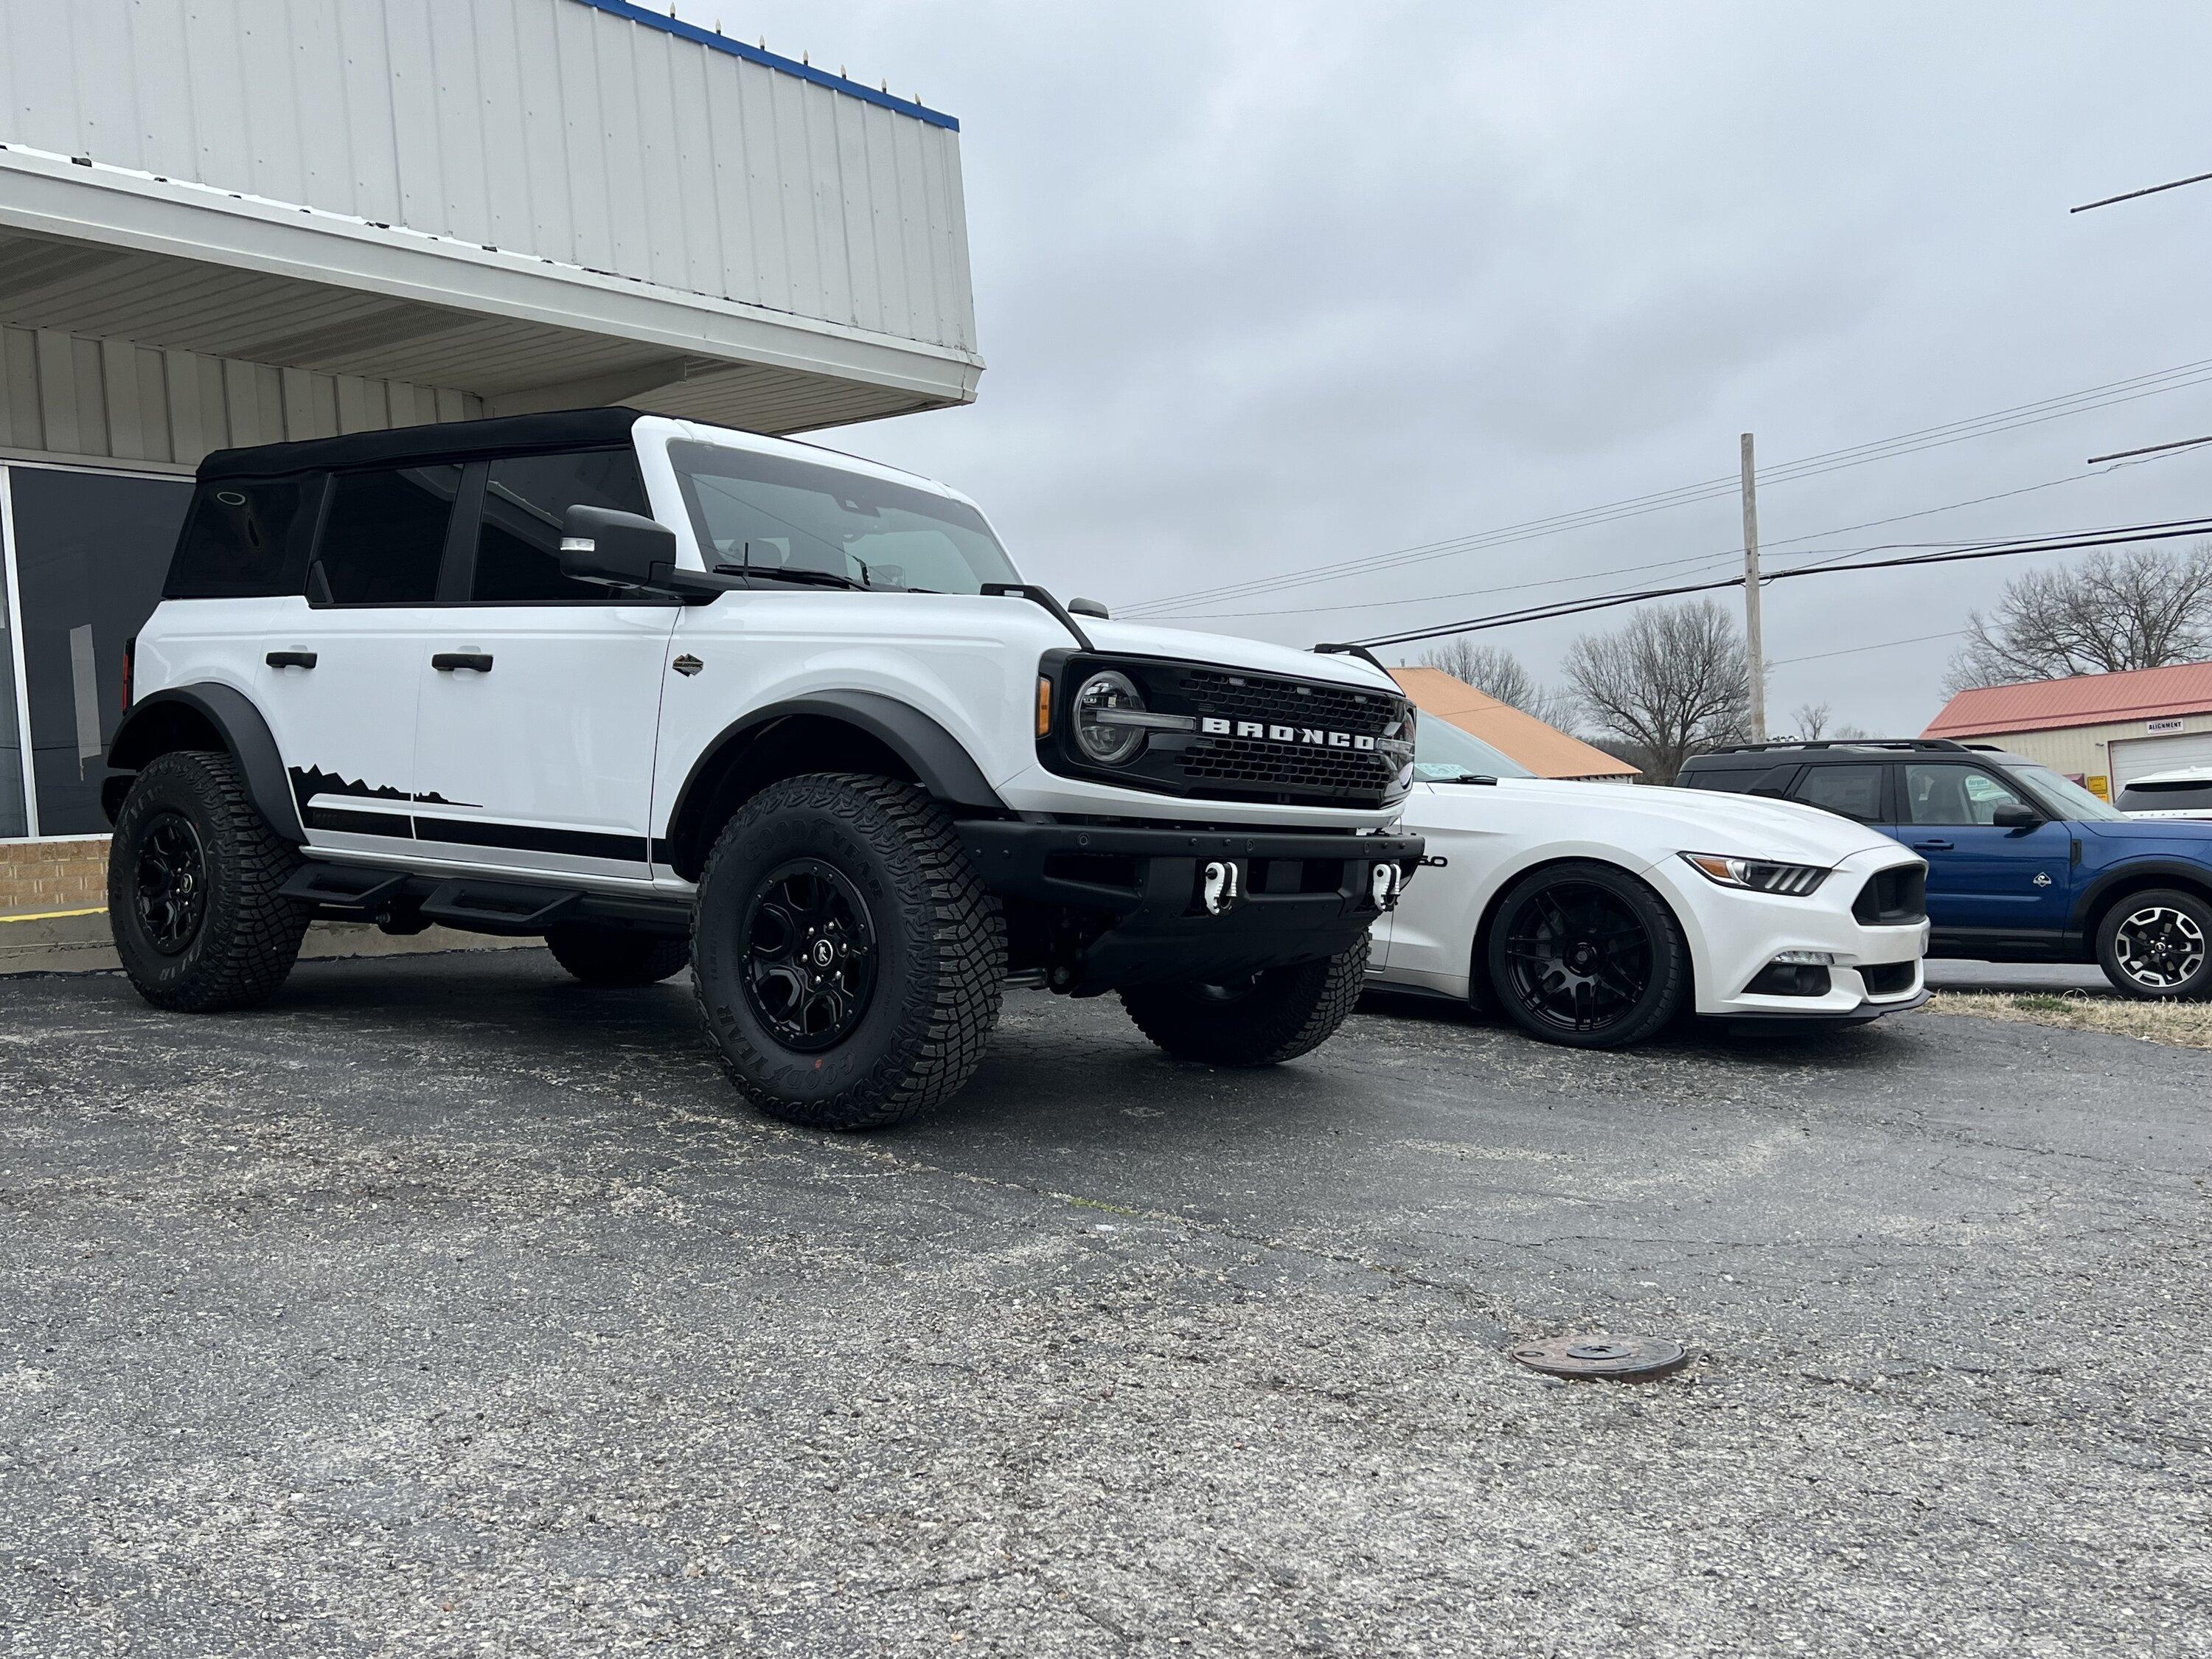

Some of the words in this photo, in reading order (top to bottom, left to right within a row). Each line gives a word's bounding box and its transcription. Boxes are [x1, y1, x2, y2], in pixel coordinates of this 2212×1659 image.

[1203, 717, 1374, 751] BRONCO
[2148, 721, 2182, 731] ALIGNMENT
[743, 818, 885, 902] GOODYEAR
[716, 1004, 855, 1090] GOODYEAR
